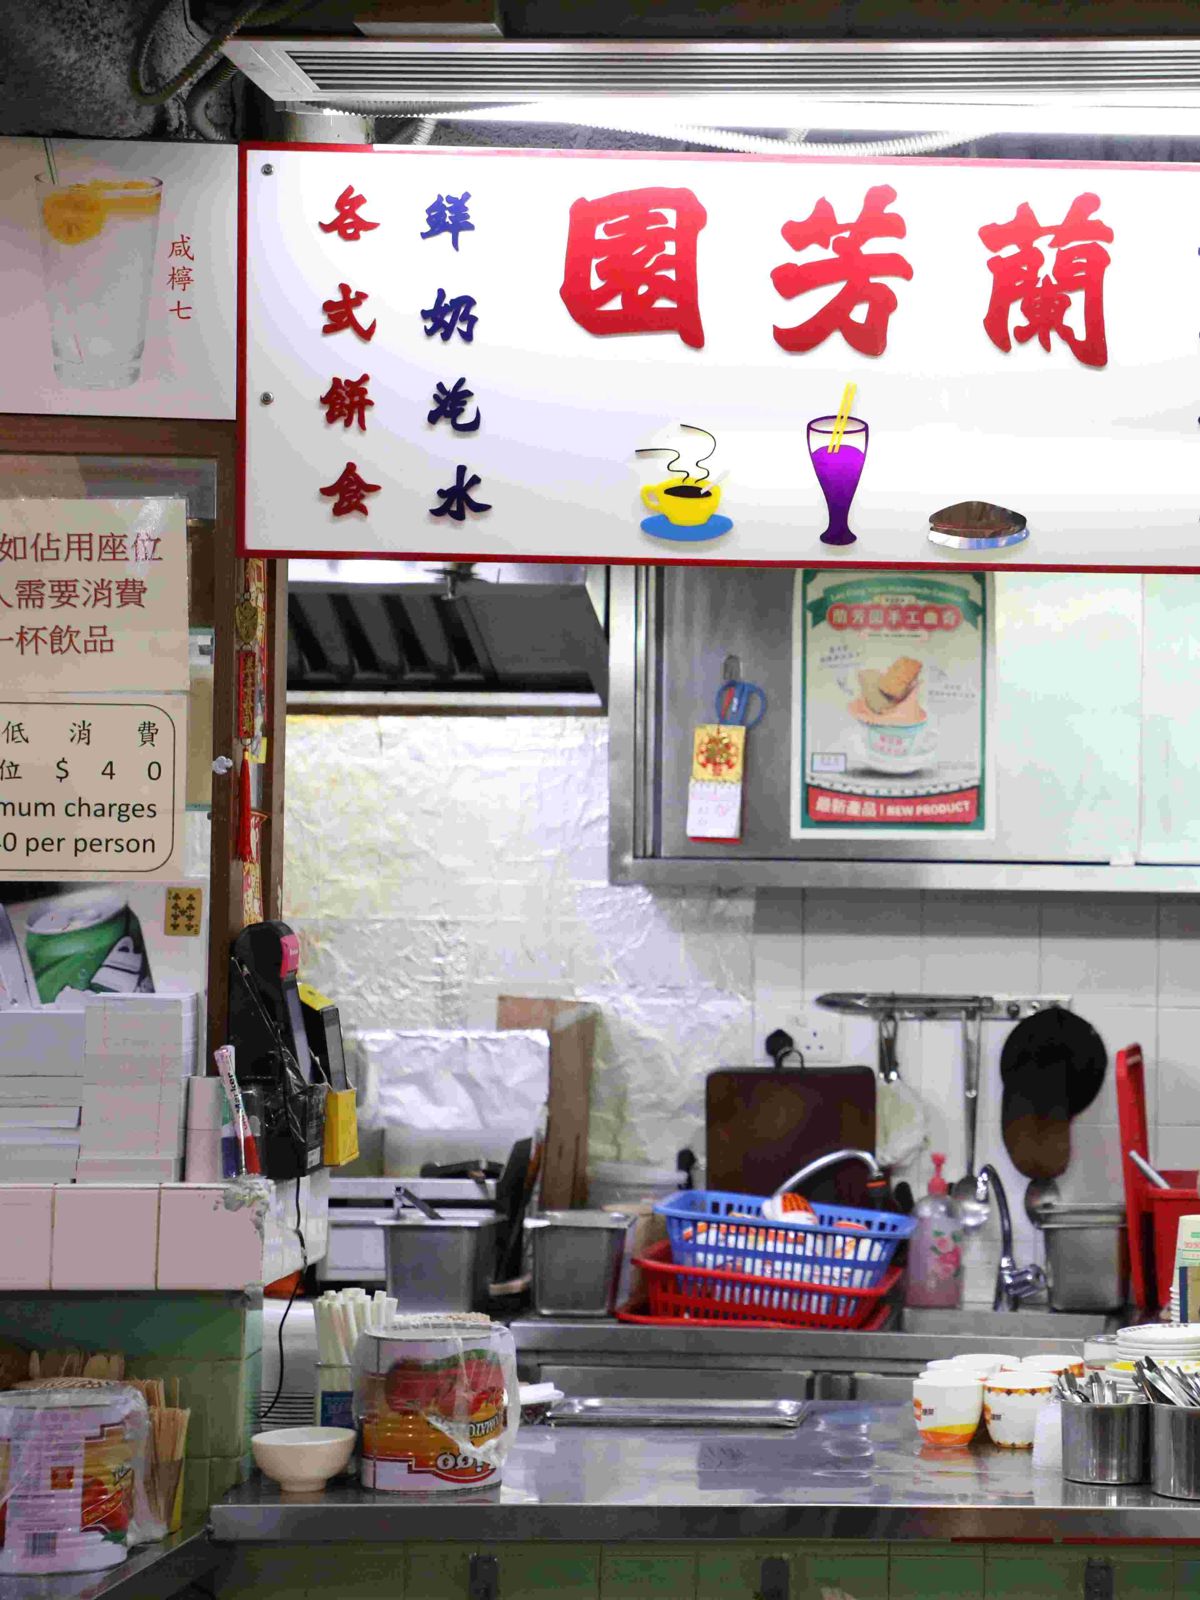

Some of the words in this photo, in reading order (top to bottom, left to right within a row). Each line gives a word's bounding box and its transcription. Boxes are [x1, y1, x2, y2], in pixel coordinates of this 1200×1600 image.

[166, 233, 195, 320] 咸檸七
[318, 184, 381, 518] 各式餅食
[0, 532, 164, 563] 如佔用座位
[64, 797, 157, 823] charges
[916, 800, 970, 817] PRODUCT
[25, 837, 65, 856] per
[73, 837, 155, 857] person
